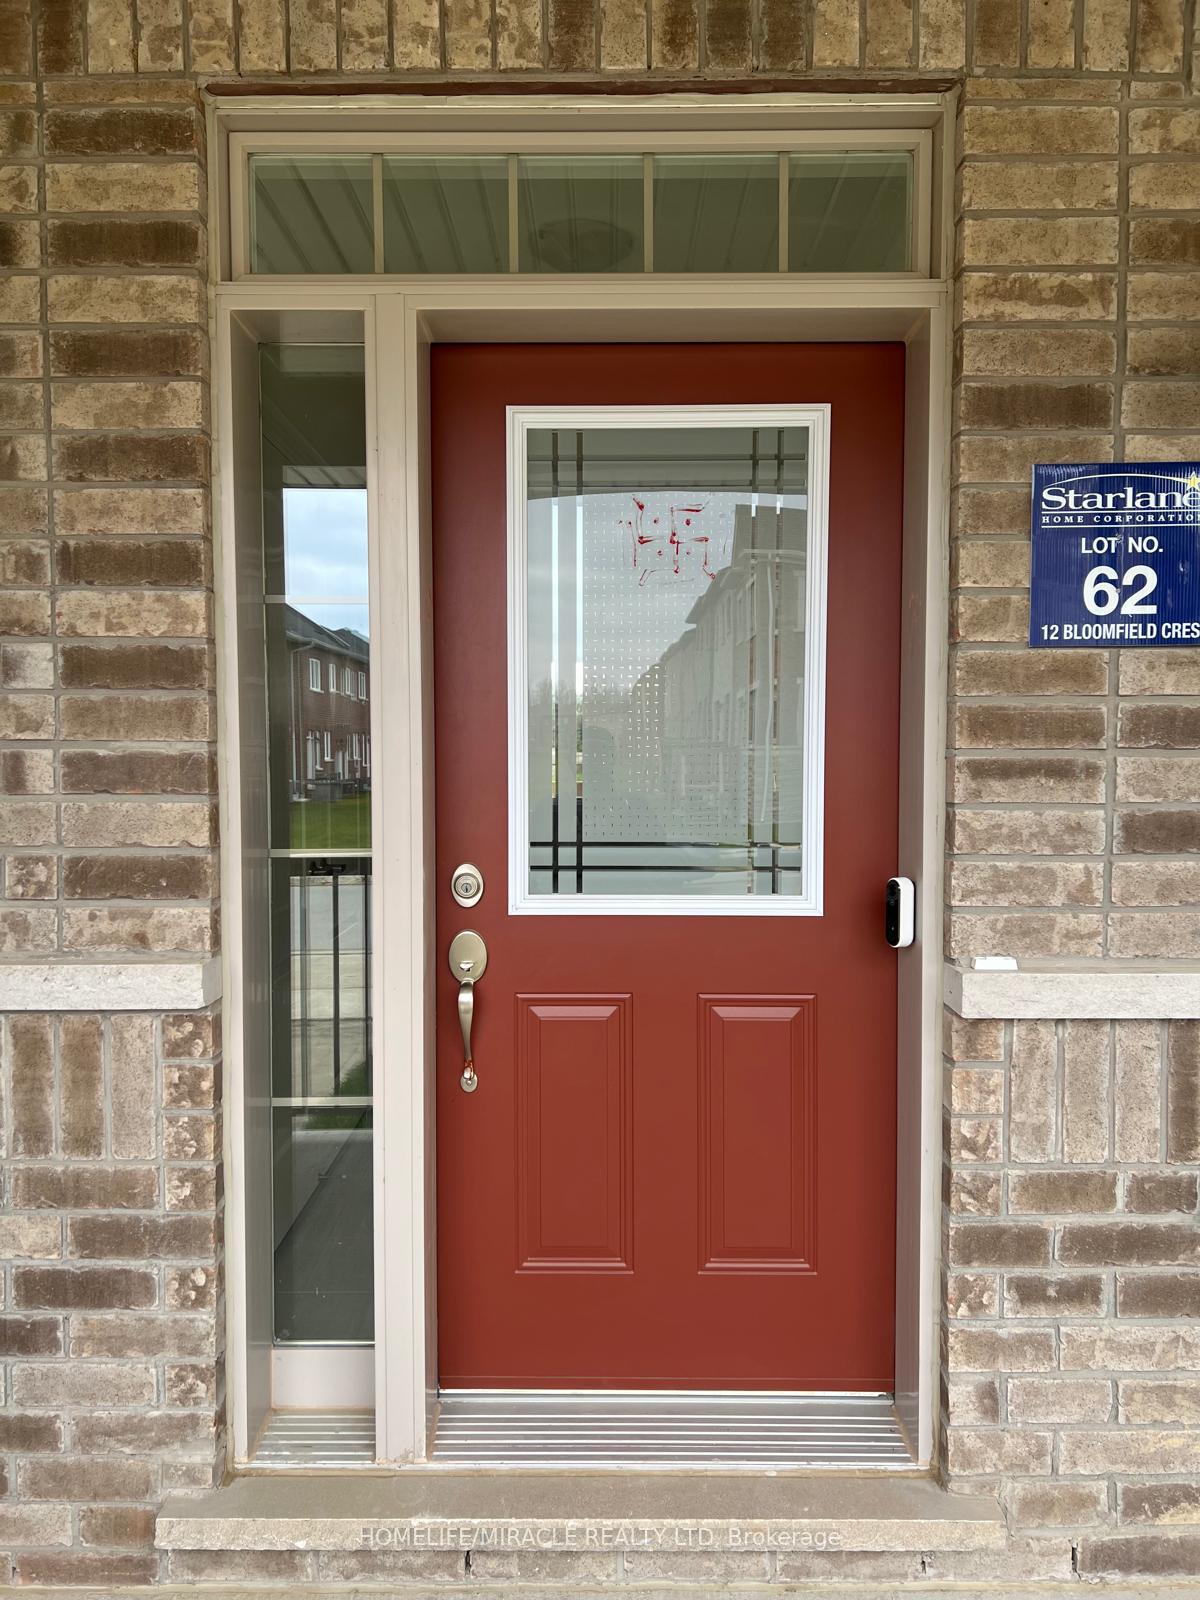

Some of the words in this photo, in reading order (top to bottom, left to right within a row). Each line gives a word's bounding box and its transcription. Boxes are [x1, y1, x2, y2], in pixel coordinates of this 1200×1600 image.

[1042, 515, 1084, 524] HOME
[1081, 537, 1118, 554] LOT
[1128, 536, 1164, 553] NO.
[1083, 565, 1158, 616] 62
[1041, 625, 1059, 640] 12
[1063, 624, 1157, 640] BLOOMFIELD
[1161, 623, 1200, 639] CRES
